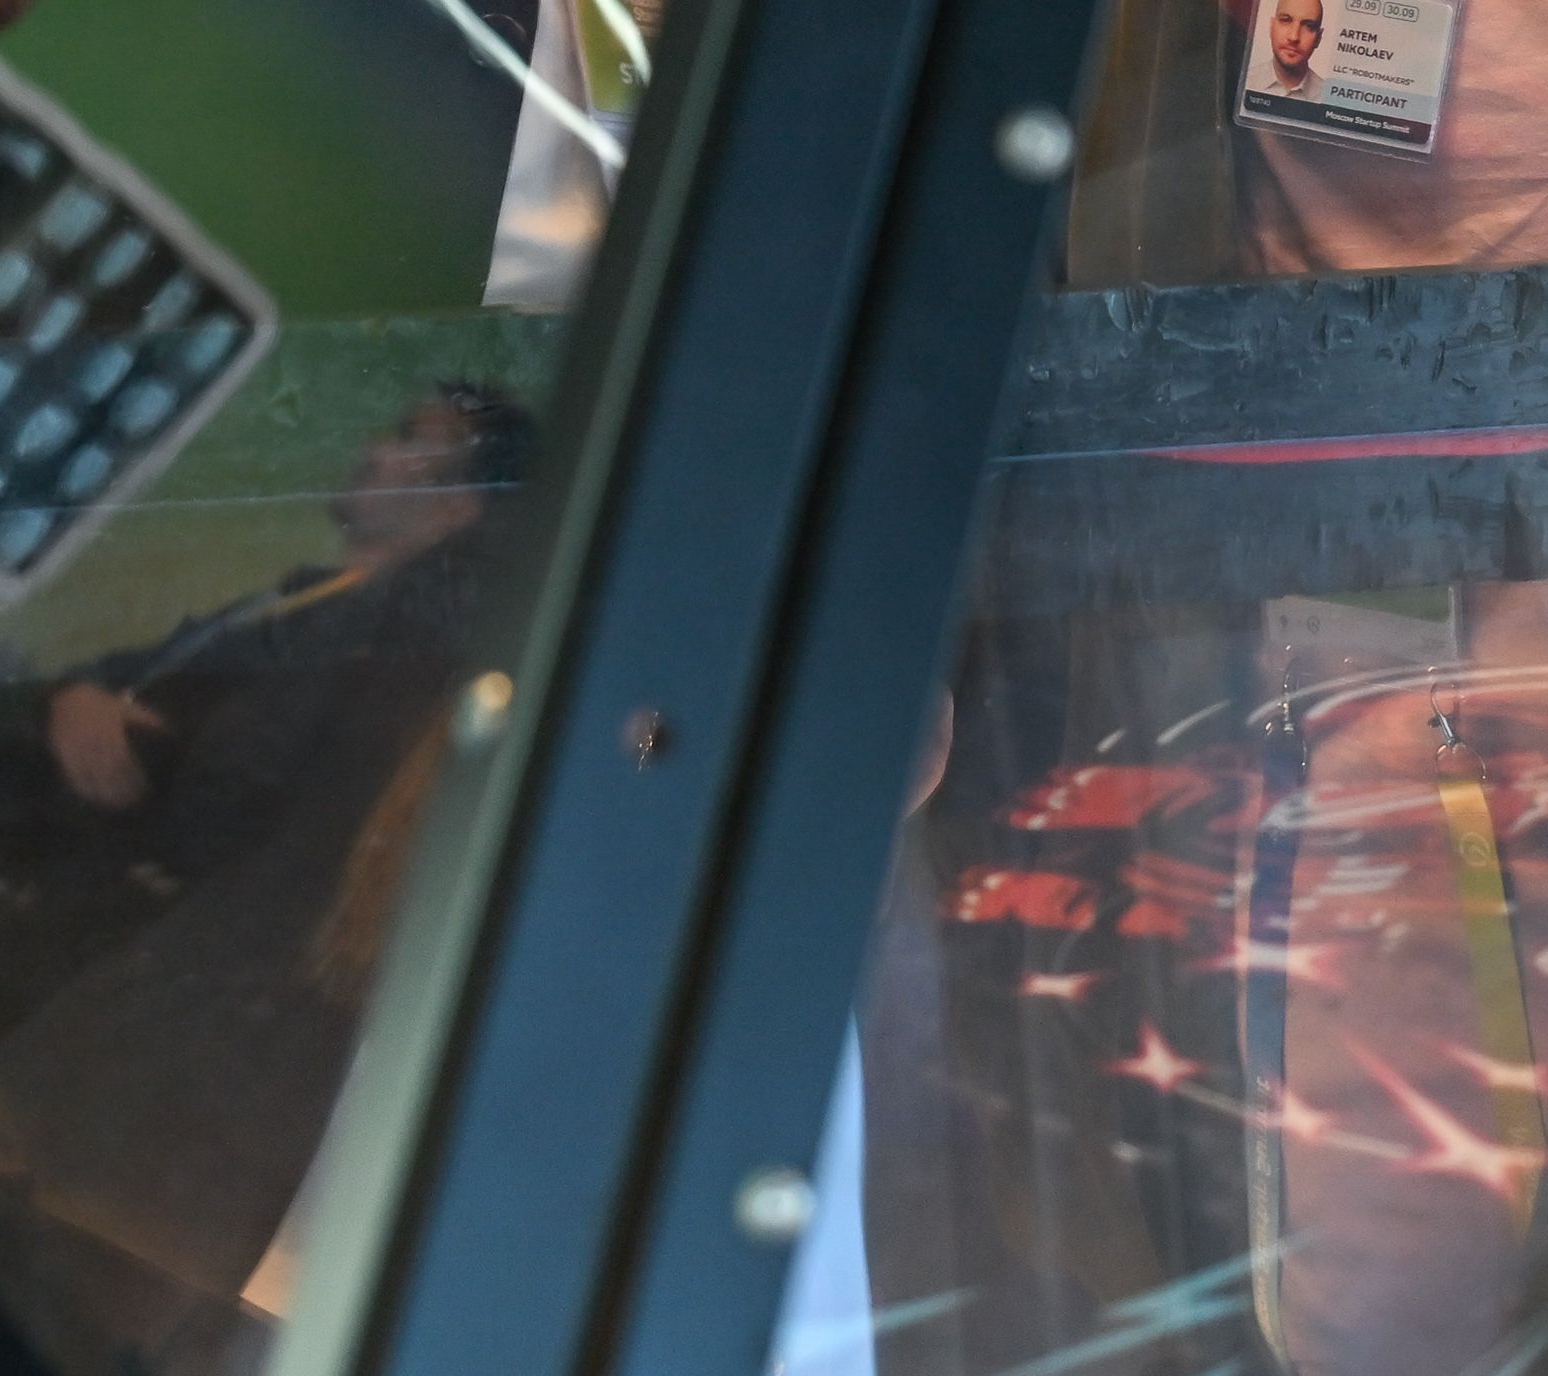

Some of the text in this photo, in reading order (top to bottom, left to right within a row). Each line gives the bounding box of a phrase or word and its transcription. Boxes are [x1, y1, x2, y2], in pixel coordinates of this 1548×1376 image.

[1387, 3, 1416, 19] 30.09
[1339, 28, 1378, 44] ARTEM
[1336, 42, 1395, 61] NIKOLAEV
[1332, 64, 1415, 86] LLC "ROBOTMAKERS"
[1329, 85, 1408, 109] PARTICIPANT
[1325, 110, 1410, 134] Moscow Startup Summit
